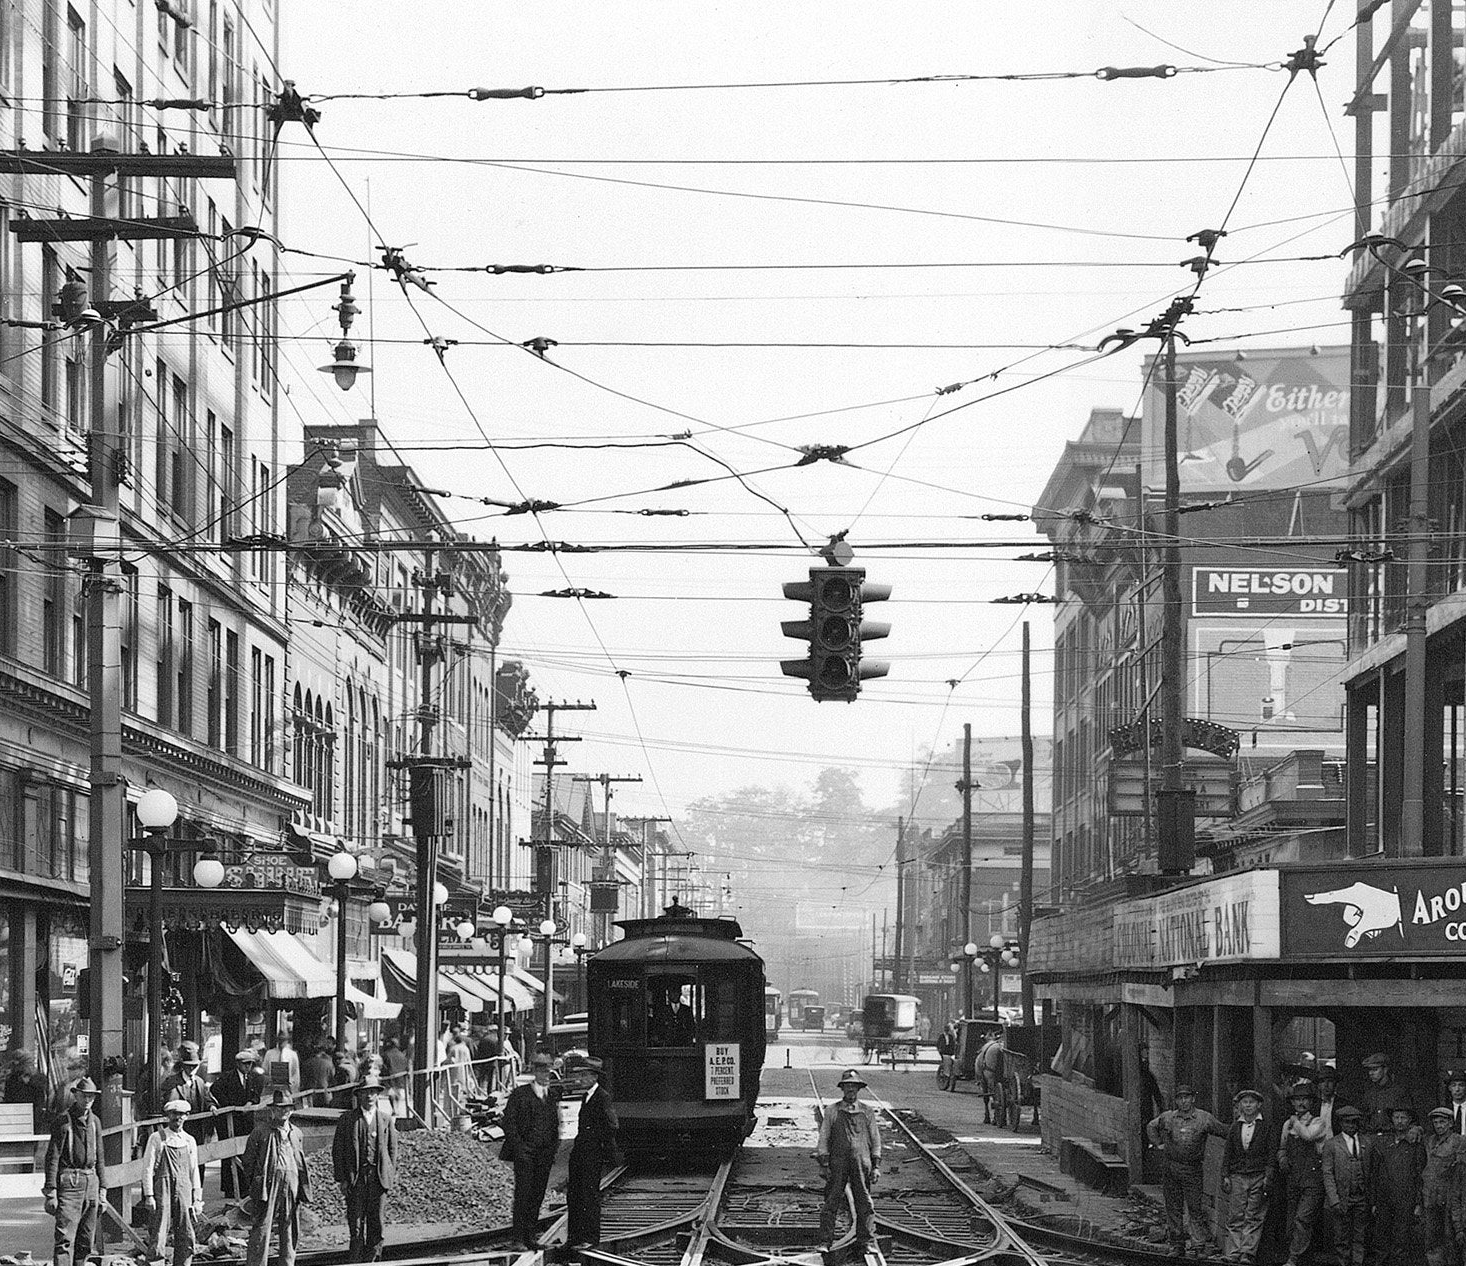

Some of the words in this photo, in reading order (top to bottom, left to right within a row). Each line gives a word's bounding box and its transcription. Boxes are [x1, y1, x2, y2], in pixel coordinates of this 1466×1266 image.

[1266, 384, 1350, 413] Either
[254, 855, 287, 866] SHOE
[1214, 900, 1251, 958] BANK
[608, 979, 640, 989] LAKESIDE
[716, 1047, 729, 1056] BUY
